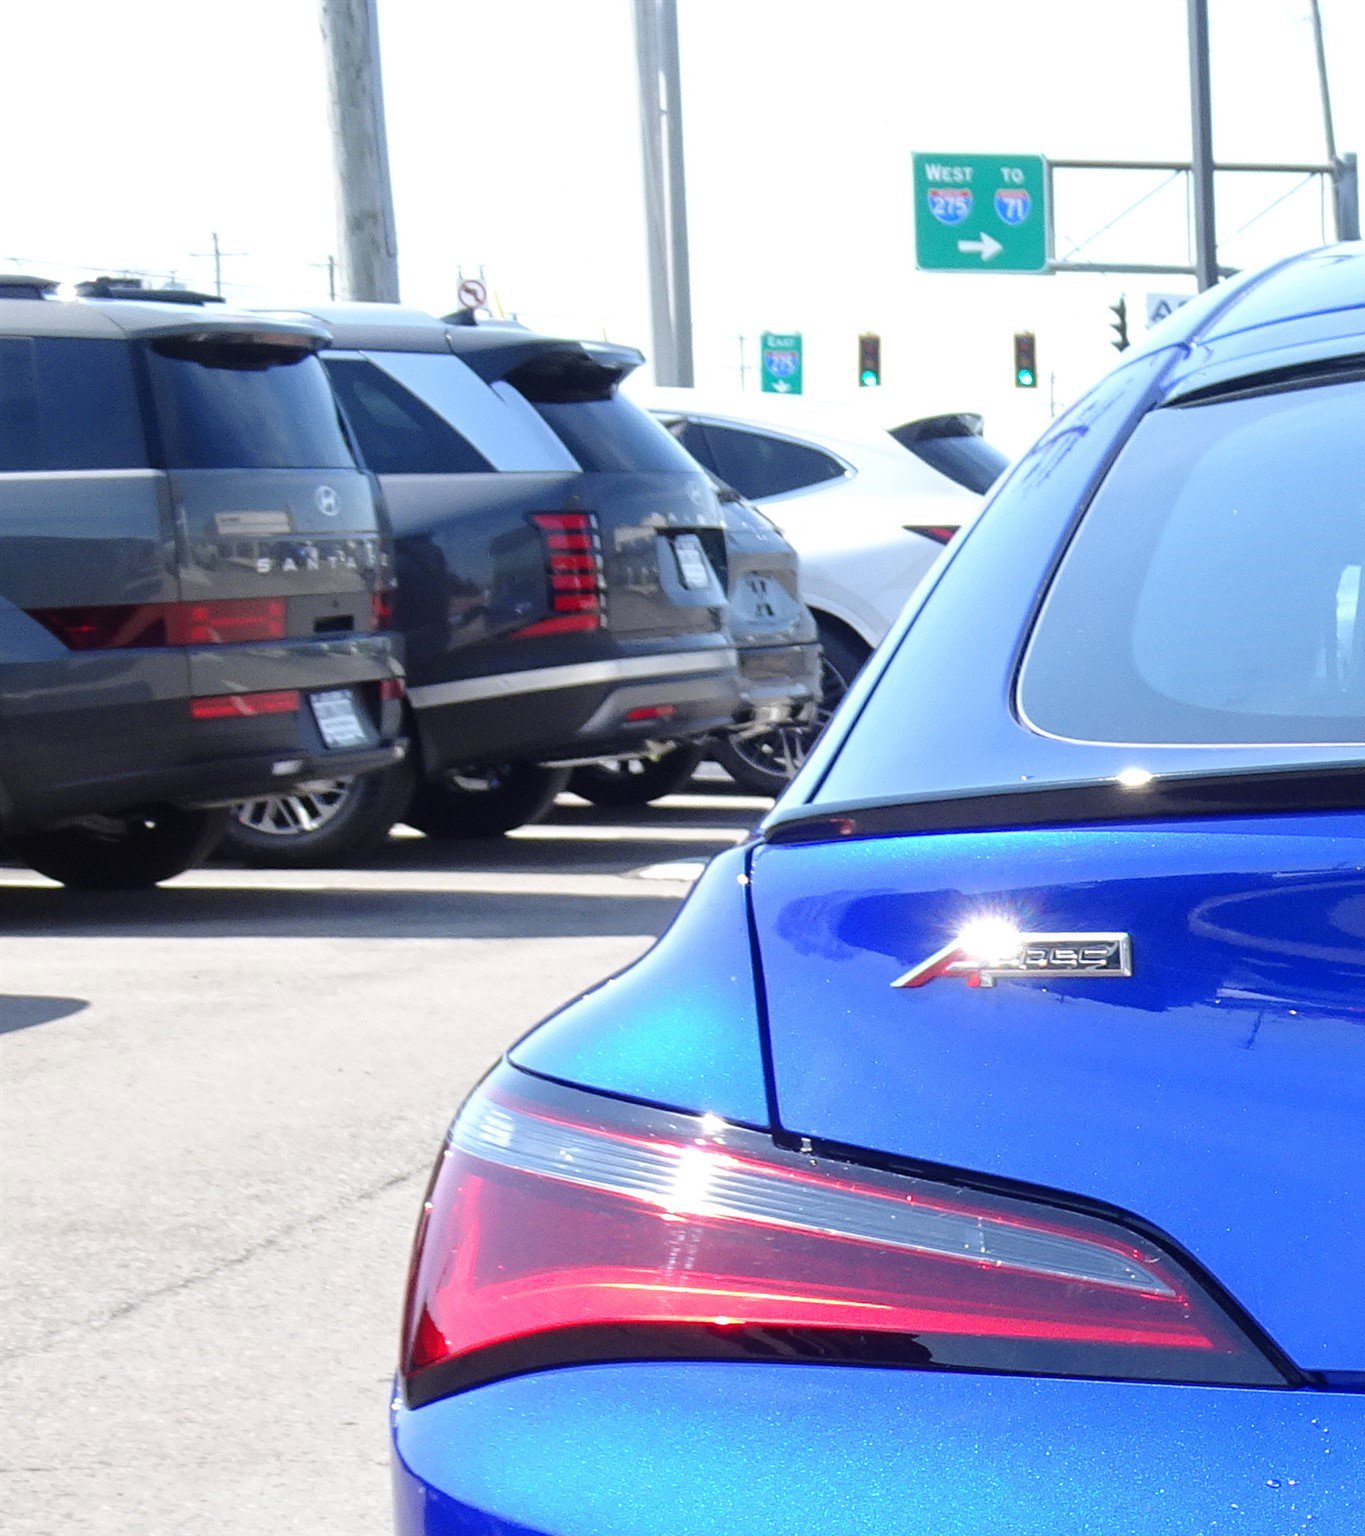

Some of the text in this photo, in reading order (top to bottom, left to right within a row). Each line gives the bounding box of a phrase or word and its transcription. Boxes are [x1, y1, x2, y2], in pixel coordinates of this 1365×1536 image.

[924, 163, 1024, 183] WEST TO
[933, 197, 967, 215] 275
[1002, 199, 1024, 220] 71
